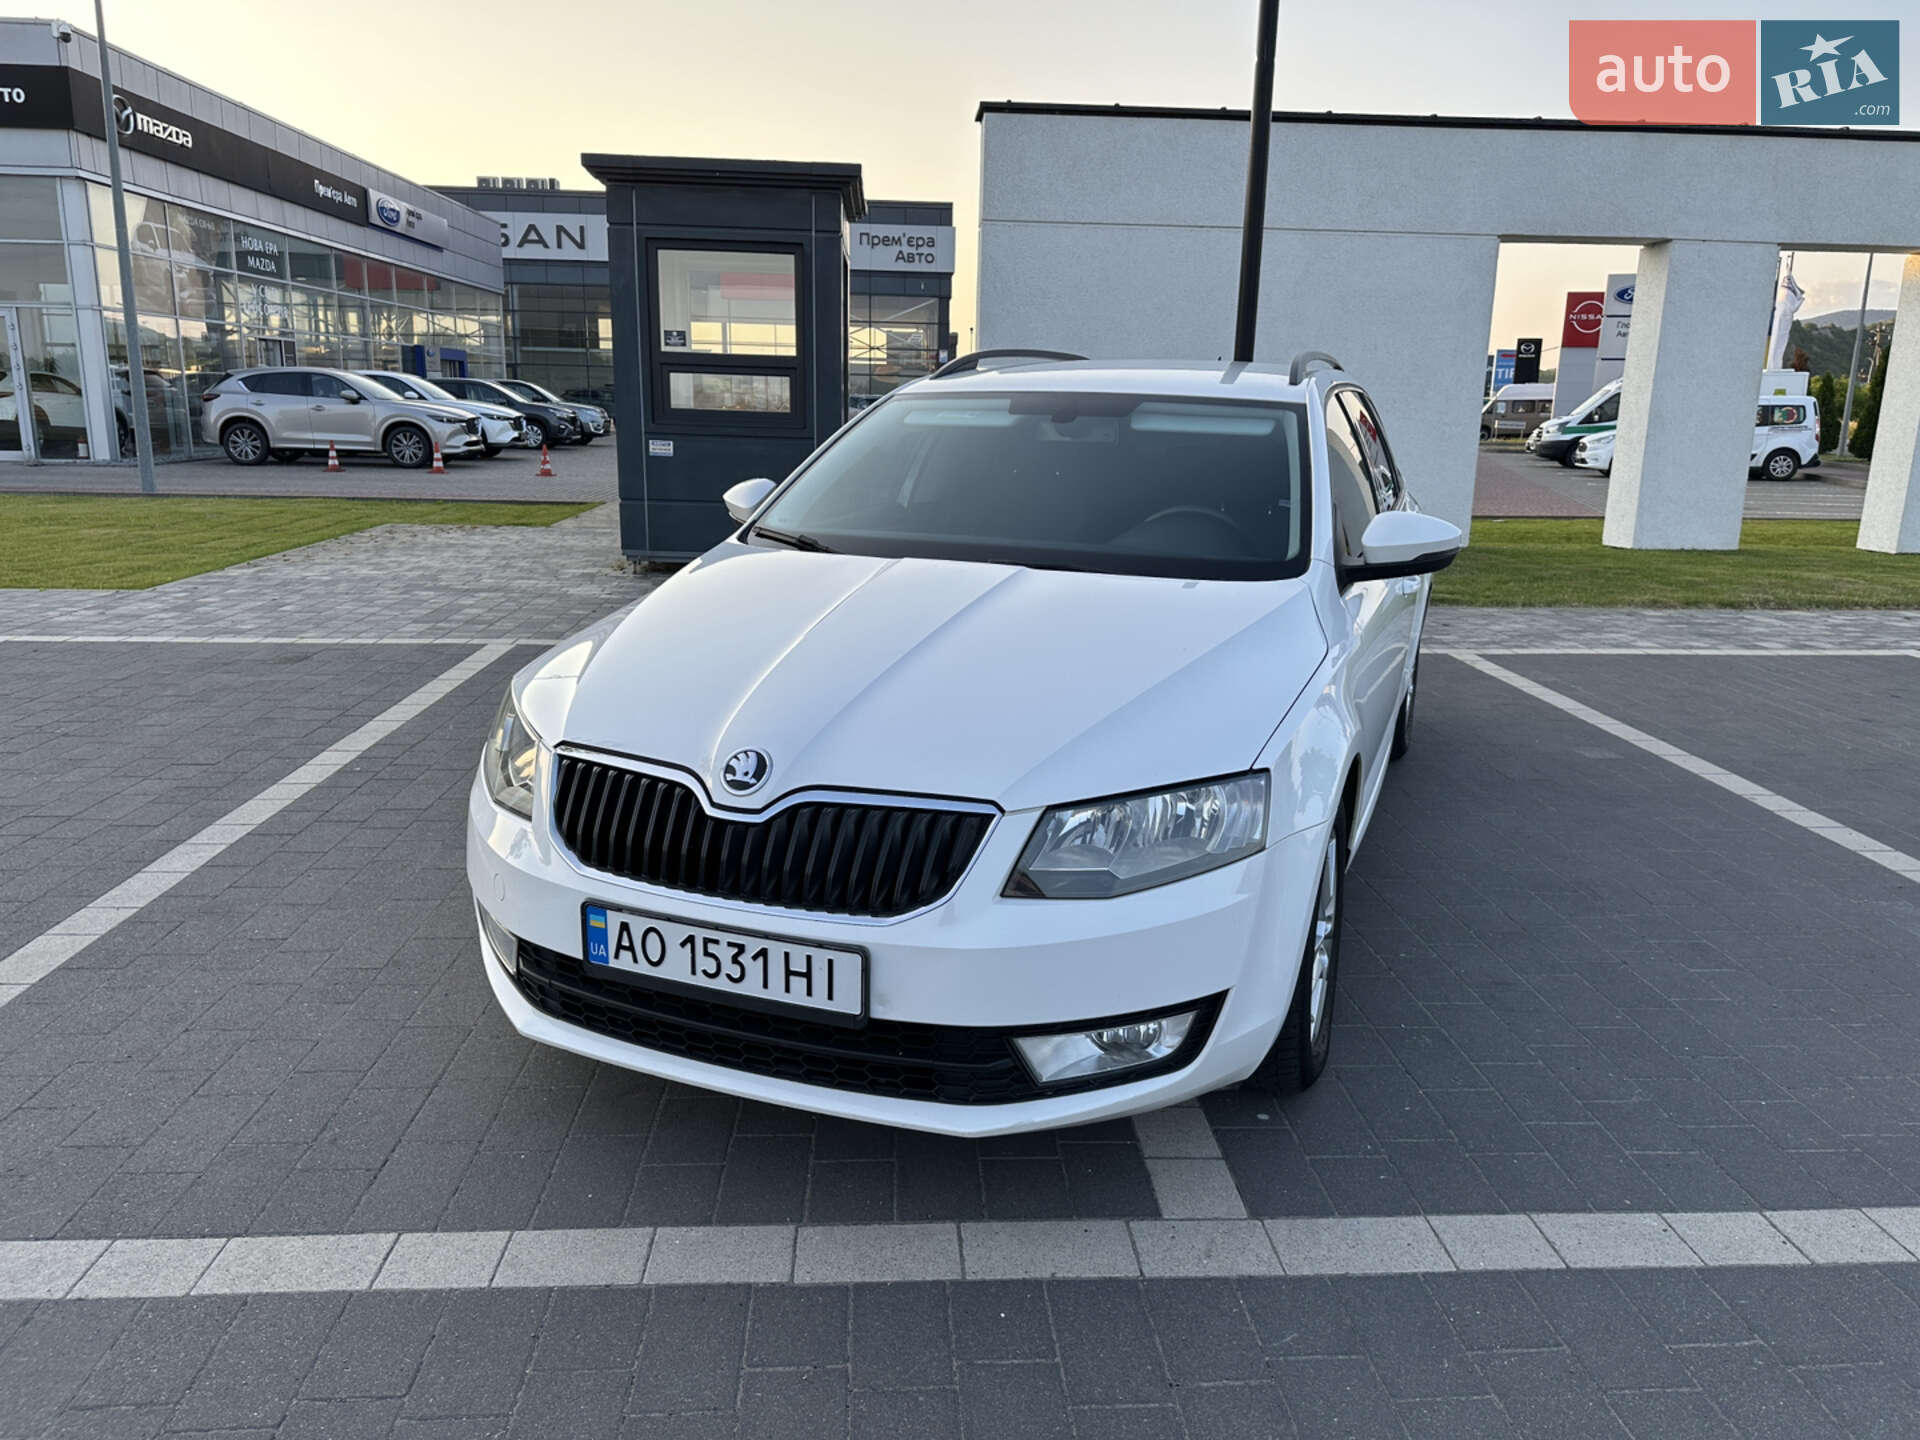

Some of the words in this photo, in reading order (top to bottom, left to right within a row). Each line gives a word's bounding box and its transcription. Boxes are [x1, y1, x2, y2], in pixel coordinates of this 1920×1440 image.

[135, 112, 193, 148] mazda
[859, 232, 935, 251] Прем'єра
[247, 255, 277, 273] MAZDA
[894, 250, 935, 264] Авто
[590, 941, 607, 957] UA
[613, 920, 667, 968] AO
[679, 933, 769, 990] 1531
[783, 950, 834, 1001] HI
